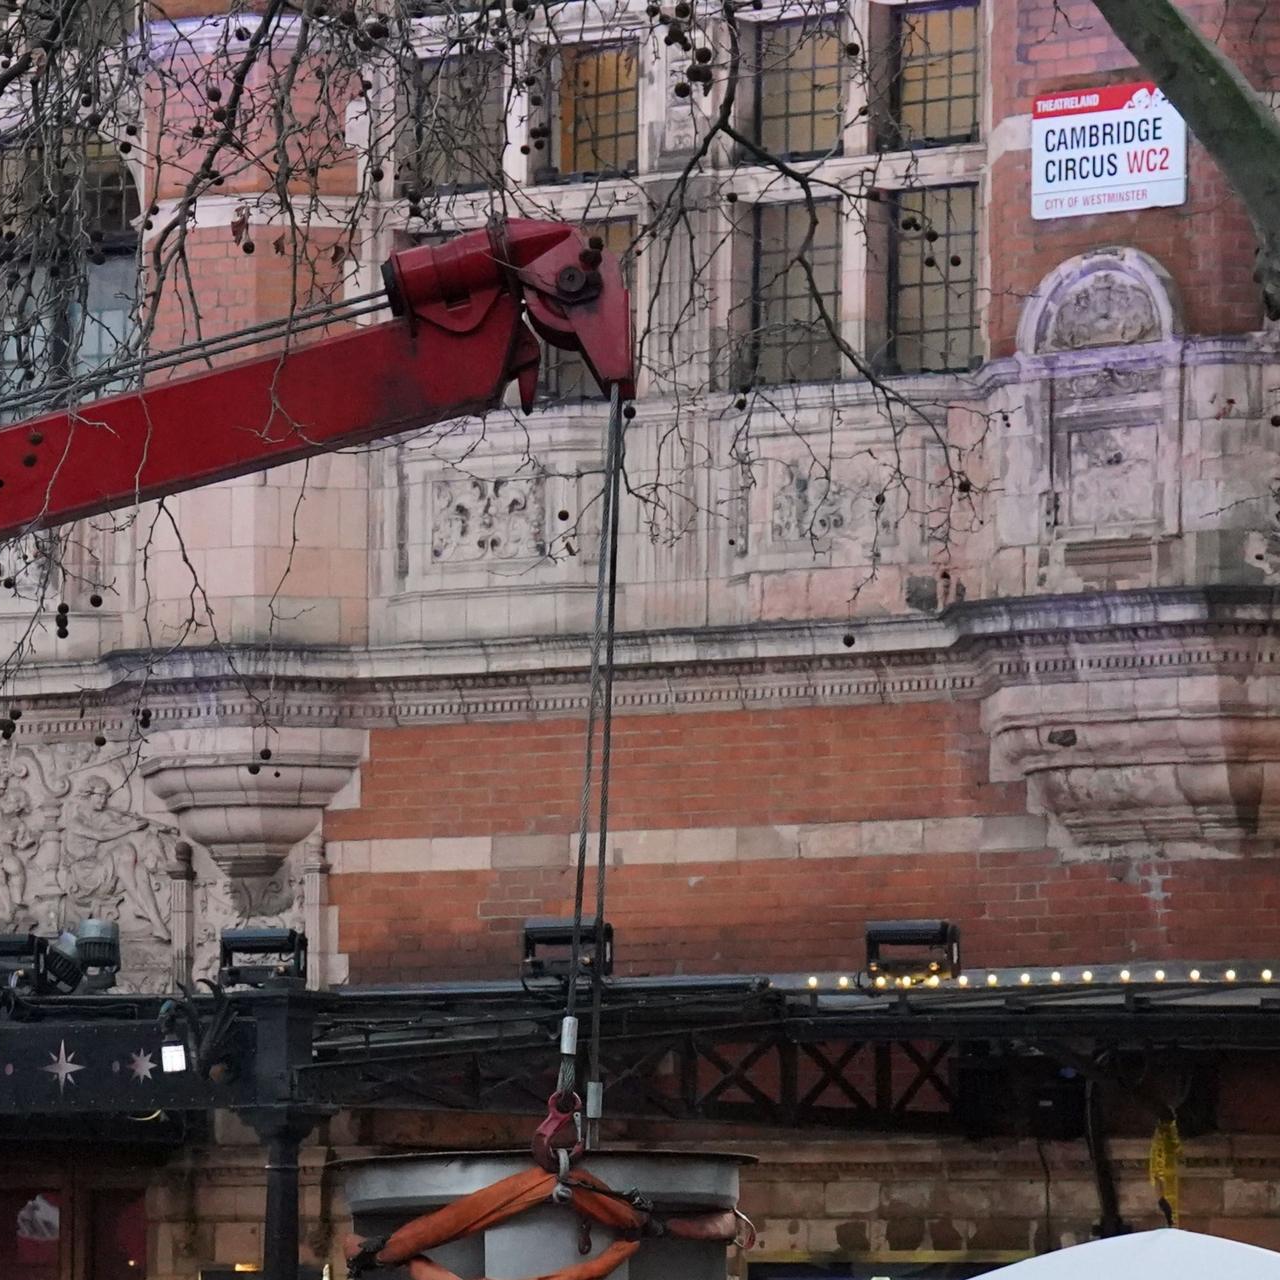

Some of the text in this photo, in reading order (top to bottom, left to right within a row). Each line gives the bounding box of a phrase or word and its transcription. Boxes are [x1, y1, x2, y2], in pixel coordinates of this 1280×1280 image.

[1036, 94, 1100, 113] THEATRELAND
[1045, 117, 1163, 153] CAMBRIDGE
[1045, 148, 1170, 183] CIRCUS WC2
[1045, 189, 1148, 210] CITY OF WESTMINSTER
